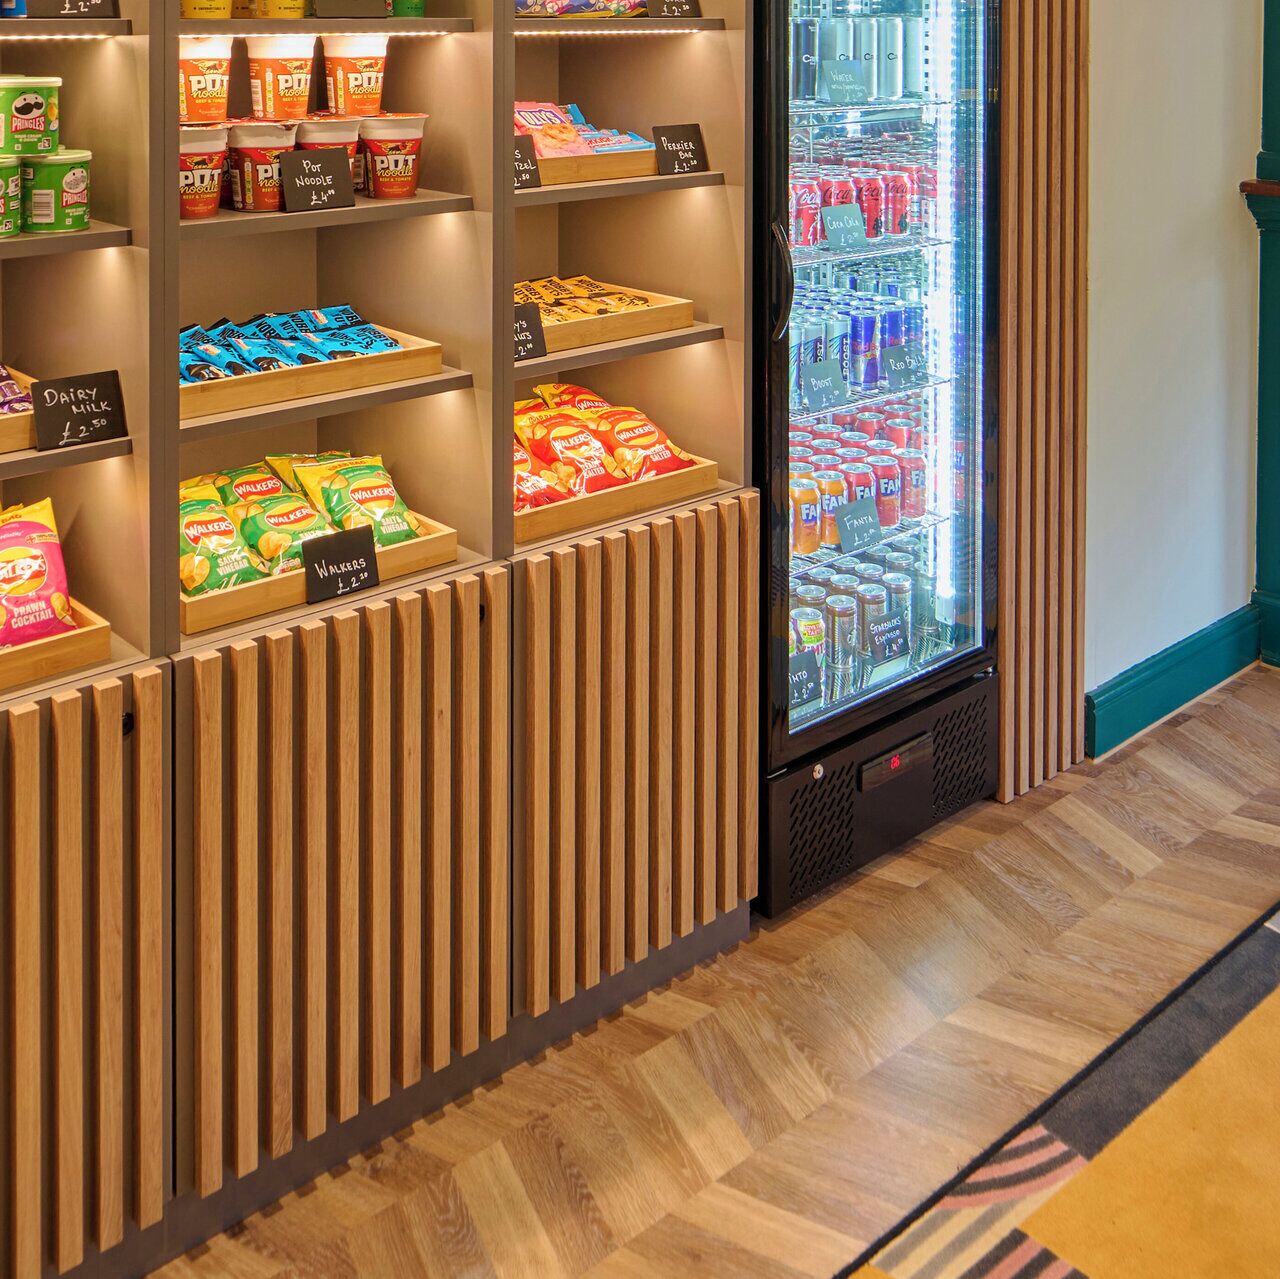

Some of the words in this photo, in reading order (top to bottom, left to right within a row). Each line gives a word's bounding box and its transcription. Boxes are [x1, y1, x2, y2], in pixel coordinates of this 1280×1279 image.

[12, 116, 45, 132] PRINGLES
[374, 154, 417, 171] POT
[376, 165, 414, 177] noodle
[179, 169, 221, 187] POT
[823, 186, 850, 204] Coca
[546, 278, 573, 299] NOBBY
[281, 320, 299, 335] NUT
[617, 423, 655, 441] WALKERS
[552, 431, 592, 451] WALKERS
[649, 451, 672, 462] SALTED
[235, 480, 280, 495] WALKERS
[351, 487, 395, 501] WALKERS
[184, 520, 233, 539] WALKERS
[381, 521, 409, 534] VINEGAR
[13, 600, 47, 618] PRAWN
[11, 610, 54, 629] COCKTAIL
